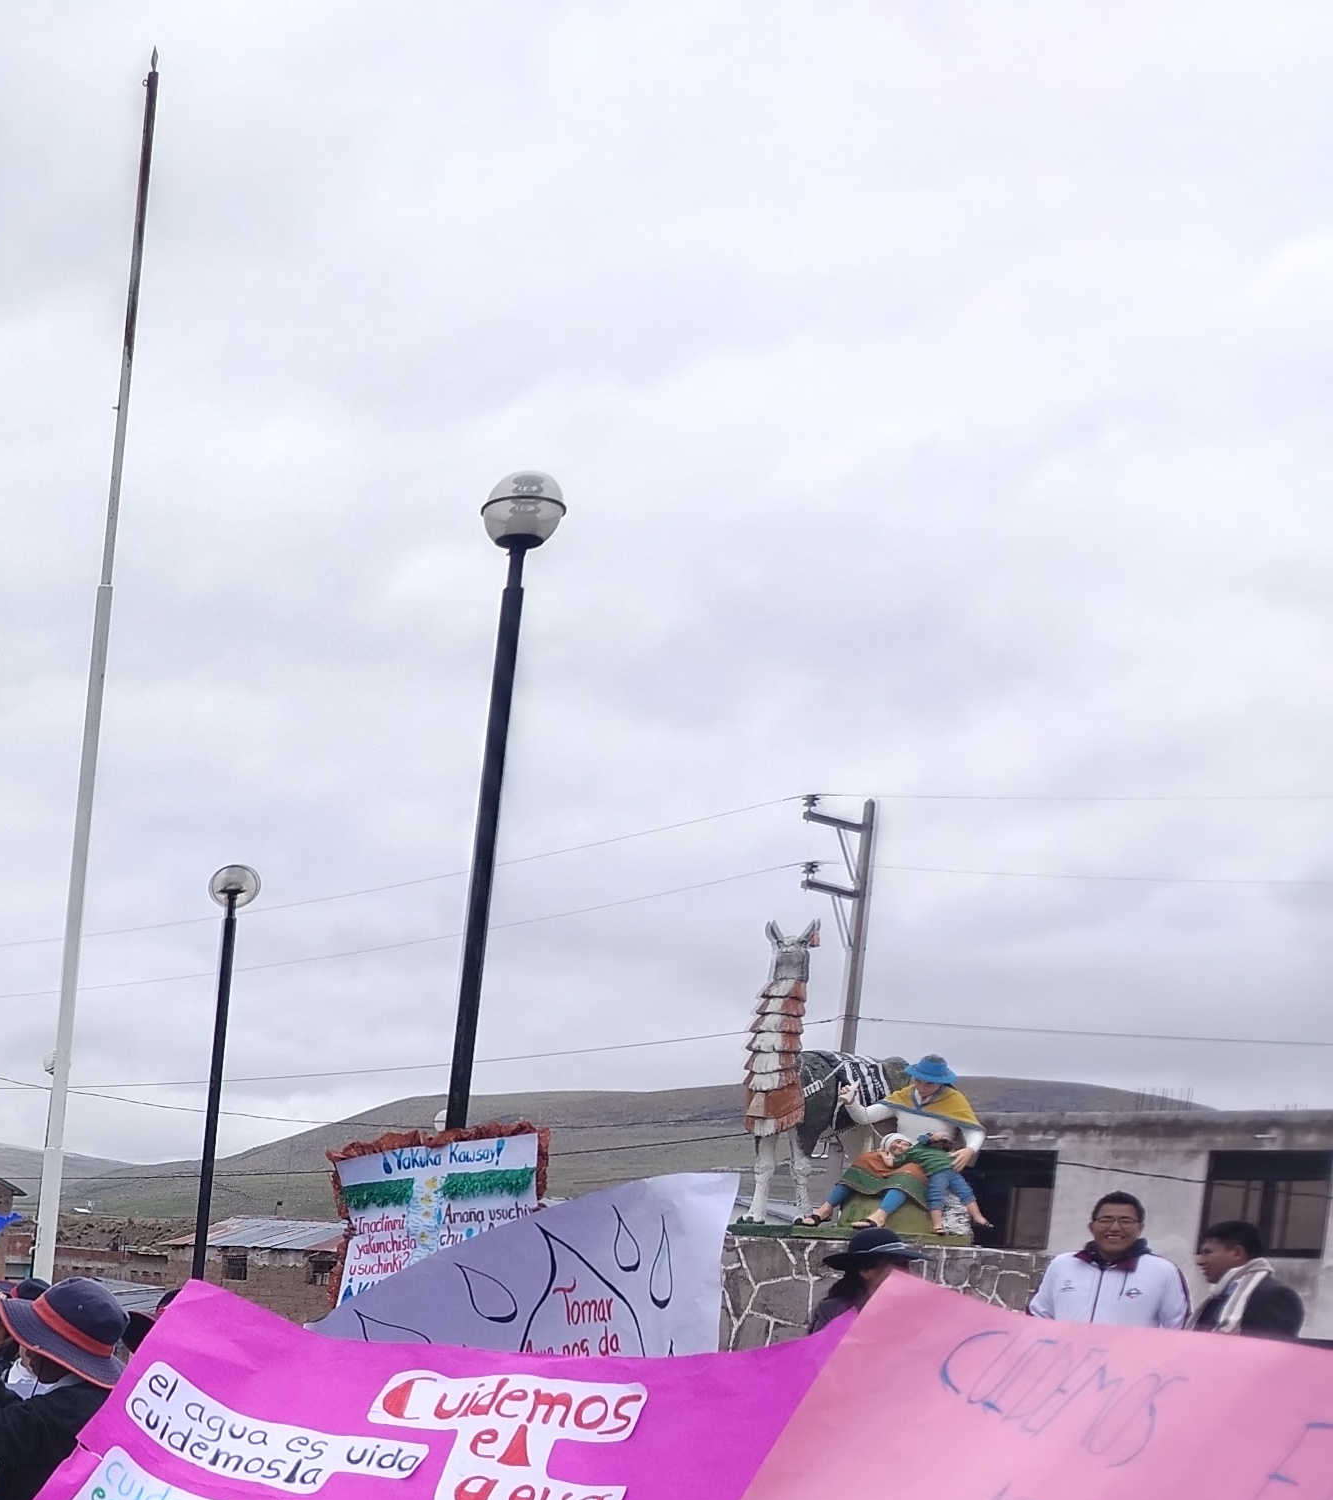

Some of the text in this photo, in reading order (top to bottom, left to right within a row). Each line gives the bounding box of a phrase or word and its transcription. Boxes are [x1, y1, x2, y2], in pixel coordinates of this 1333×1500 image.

[553, 1276, 613, 1325] Tomar
[599, 1326, 621, 1357] da
[148, 1373, 178, 1403] el
[185, 1402, 269, 1446] agua
[286, 1433, 329, 1460] es
[382, 1377, 643, 1435] Cuidemos
[939, 1330, 1190, 1469] CUIDEMOS
[131, 1397, 323, 1486] cuidemosla
